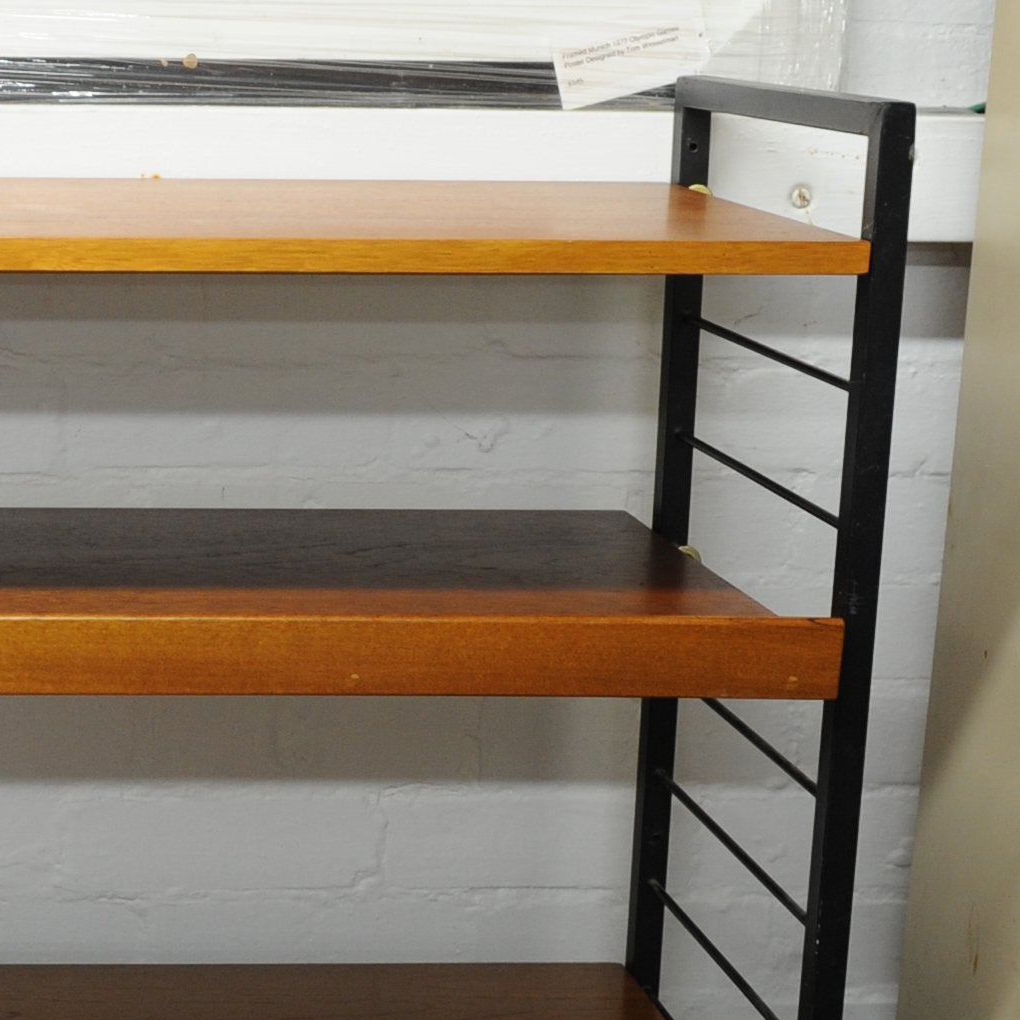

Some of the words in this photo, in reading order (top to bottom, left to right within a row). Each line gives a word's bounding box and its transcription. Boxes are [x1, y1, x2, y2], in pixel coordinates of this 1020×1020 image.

[562, 49, 587, 60] Framed
[588, 42, 611, 52] Munich
[629, 31, 655, 43] Olympic
[657, 26, 679, 35] Games
[564, 59, 584, 68] Poster
[586, 50, 616, 63] Designed
[626, 45, 640, 53] Tom
